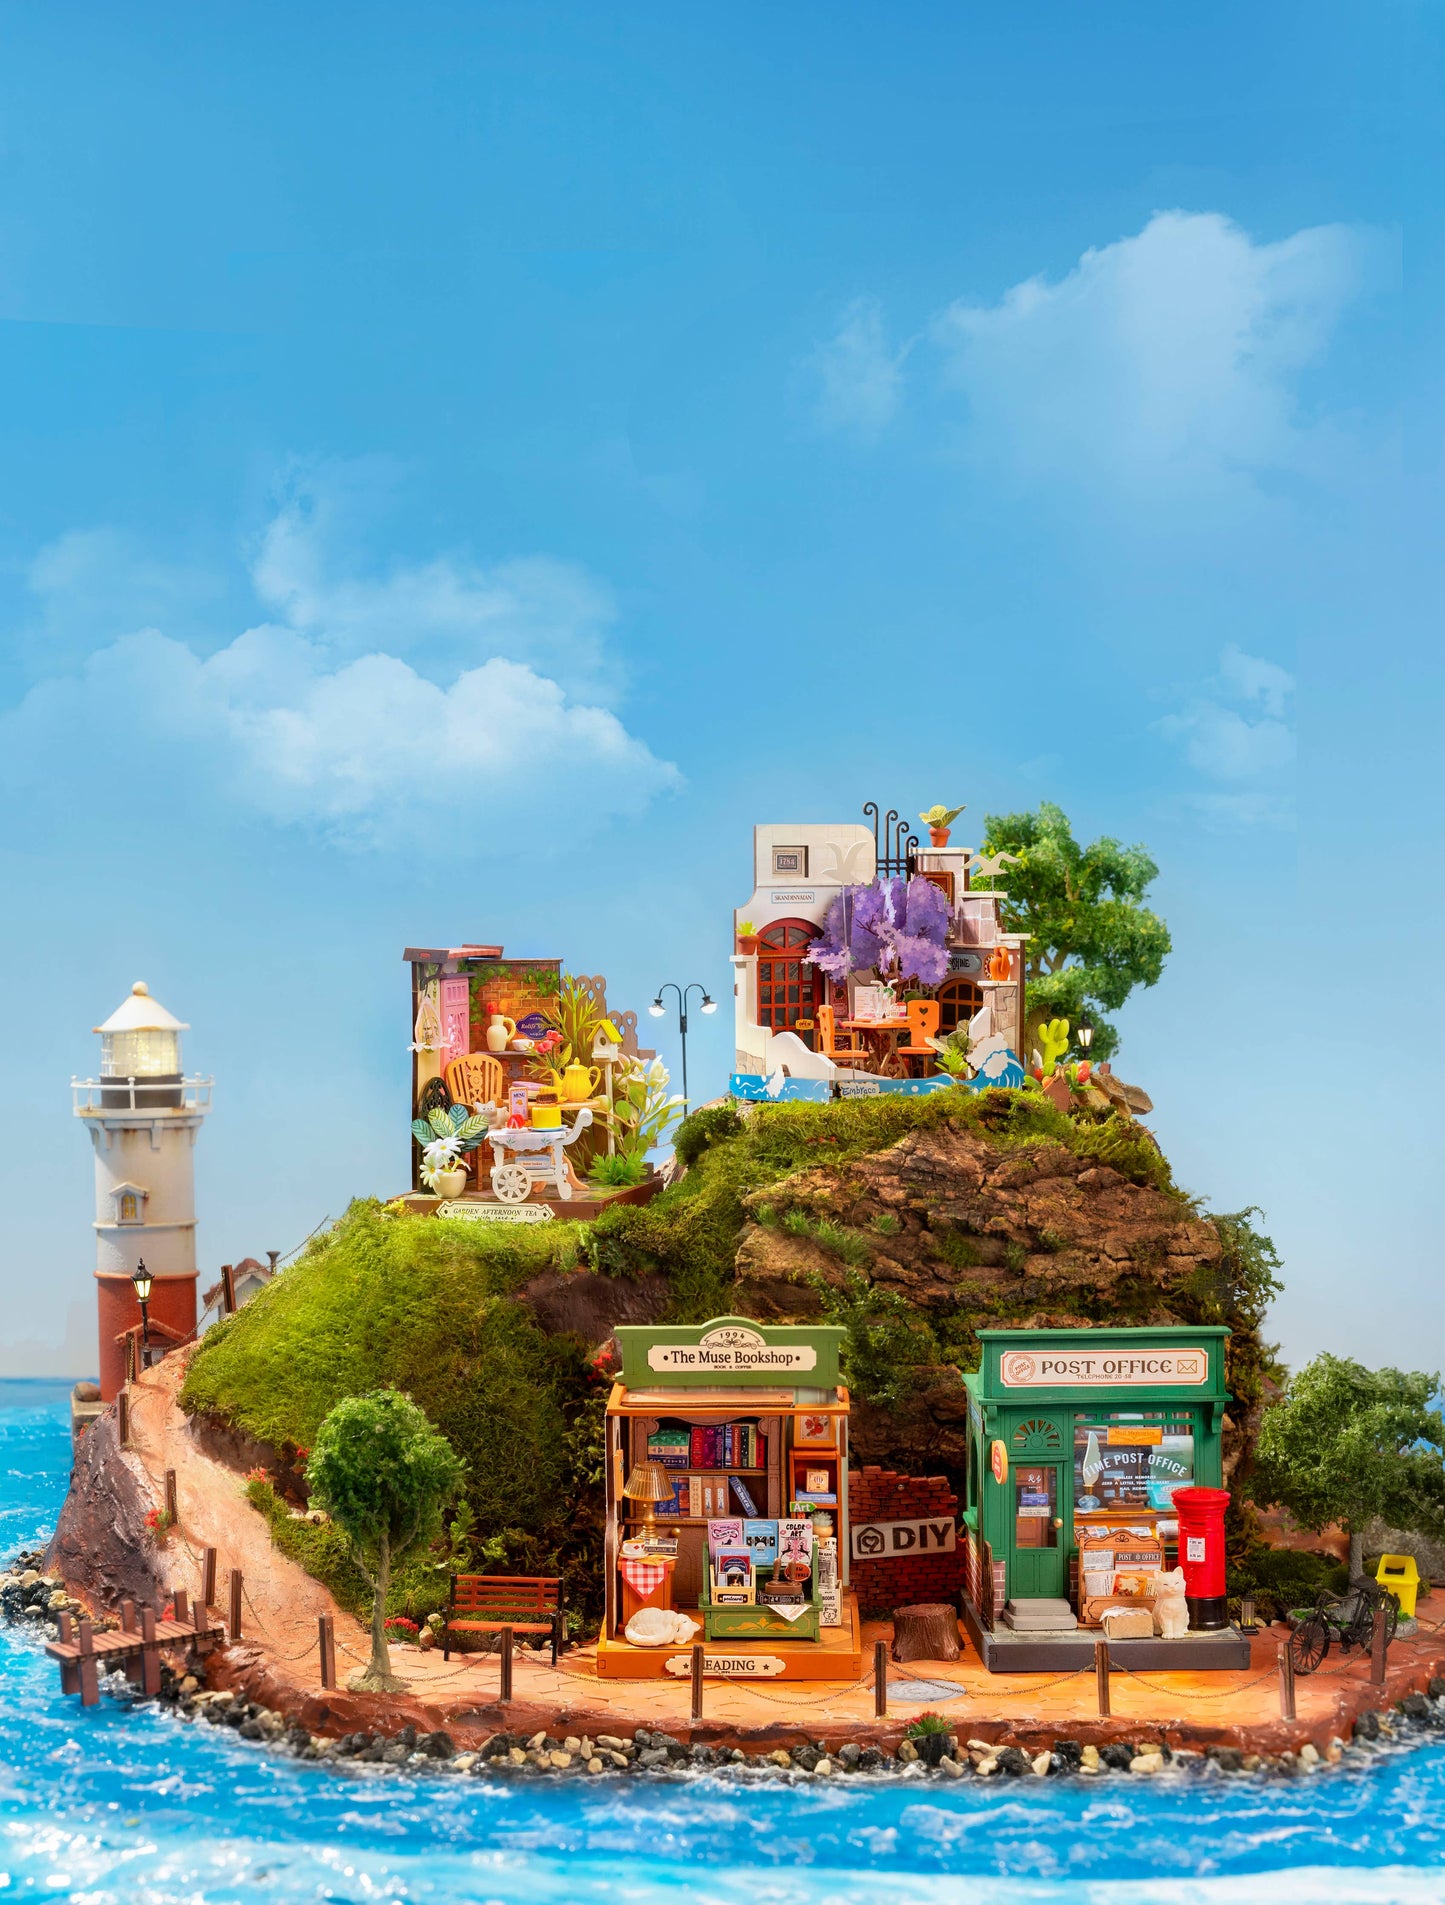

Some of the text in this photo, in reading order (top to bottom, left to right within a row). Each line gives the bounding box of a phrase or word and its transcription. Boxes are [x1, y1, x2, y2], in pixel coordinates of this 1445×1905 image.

[720, 1331, 745, 1340] 1994
[671, 1351, 793, 1366] The Muse Bookshop
[1041, 1359, 1172, 1375] POST OFFICE
[1084, 1452, 1188, 1478] TIME POST OFFICE
[793, 1502, 811, 1512] Art
[786, 1523, 806, 1531] COLOR
[892, 1523, 952, 1551] DIY
[1118, 1553, 1160, 1561] POST OFFICE
[702, 1660, 755, 1671] EADING
